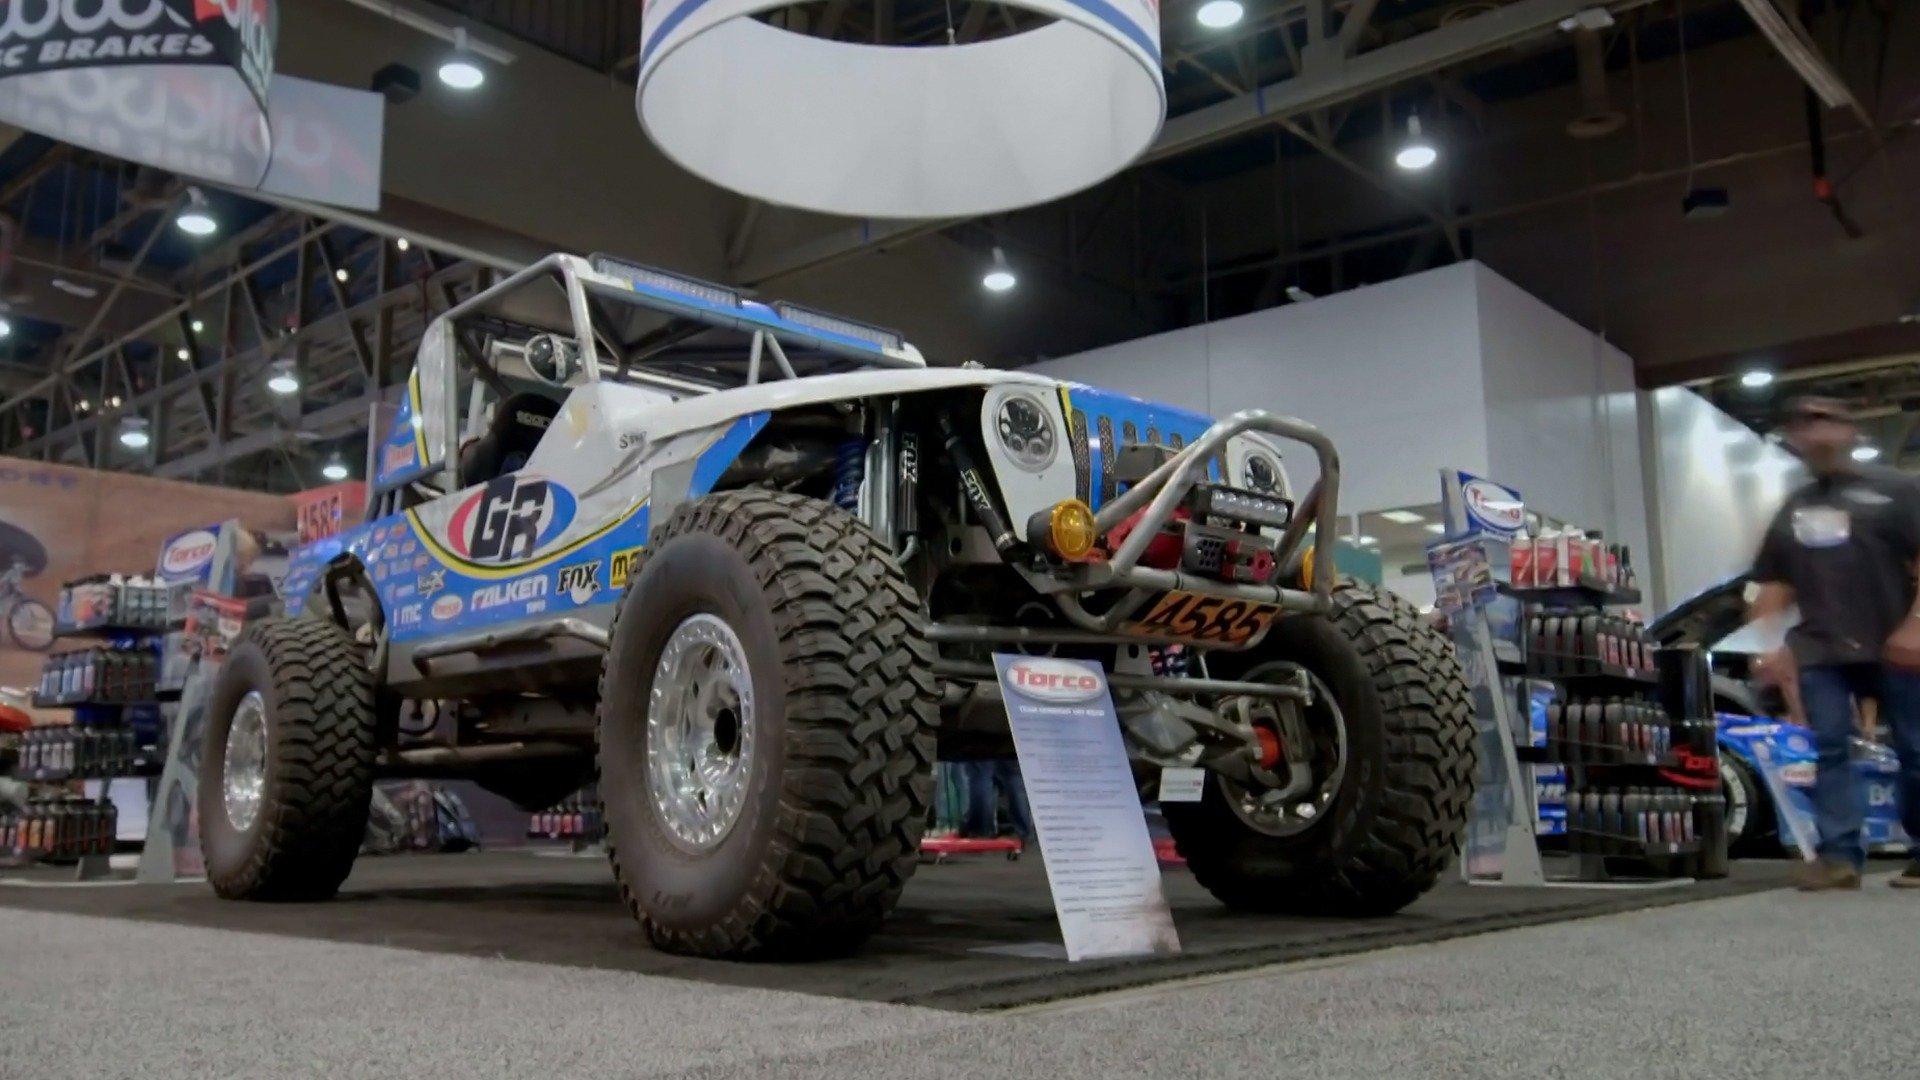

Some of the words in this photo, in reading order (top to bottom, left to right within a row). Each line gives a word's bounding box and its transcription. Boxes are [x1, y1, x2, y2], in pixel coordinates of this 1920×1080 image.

[38, 34, 215, 63] BRAKES
[470, 474, 548, 562] GR
[1012, 665, 1098, 690] Torco
